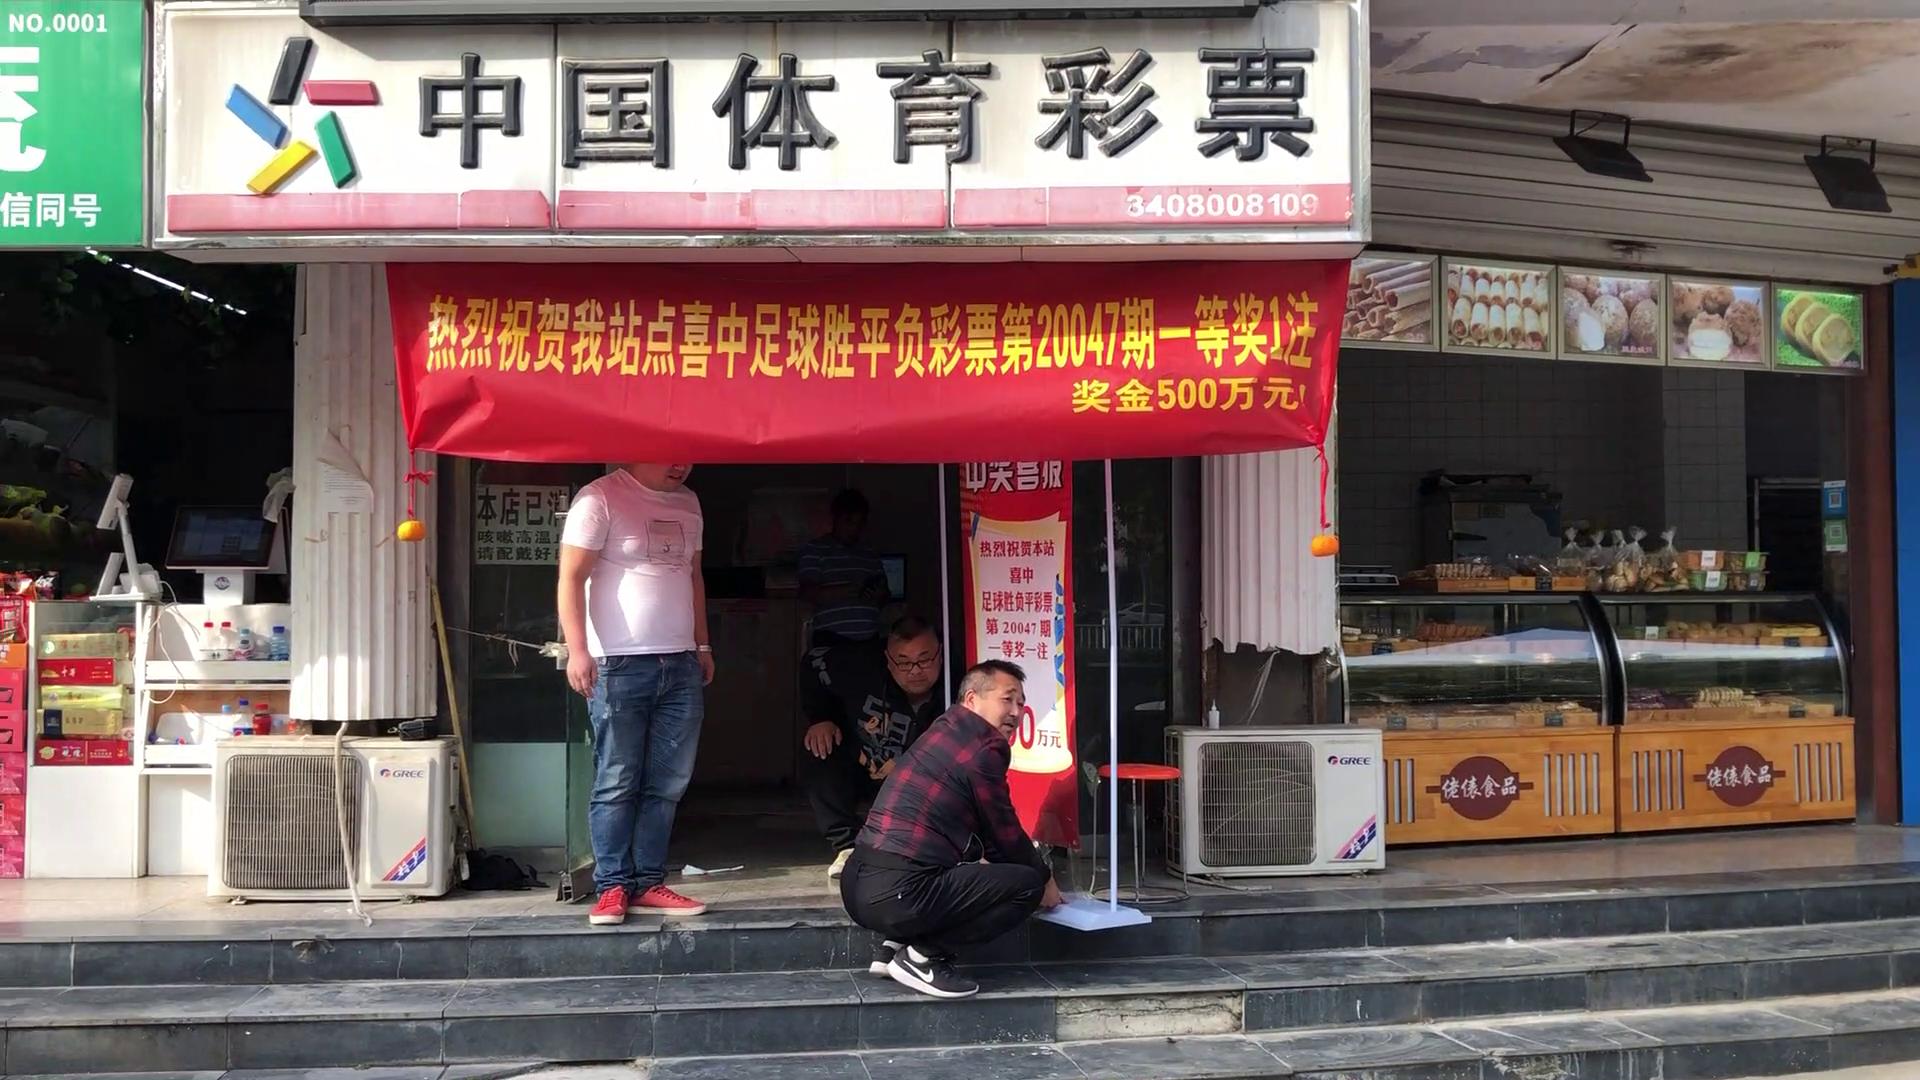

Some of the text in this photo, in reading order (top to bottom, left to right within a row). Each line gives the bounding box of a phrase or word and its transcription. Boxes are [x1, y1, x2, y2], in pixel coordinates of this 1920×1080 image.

[9, 14, 107, 33] NO.0001
[419, 48, 1315, 170] 中国体育彩票
[1126, 193, 1319, 217] 3408008109
[426, 291, 1319, 380] 热烈祝贺我站点喜中足球胜平负彩票第20047期一等奖1注
[980, 540, 1055, 557] 热烈祝贺本站
[1010, 567, 1034, 584] 喜中
[982, 591, 1053, 613] 足球胜负平彩票
[986, 618, 1051, 637] 第 20047 期
[988, 640, 1048, 660] 一等奖一注
[1340, 757, 1371, 766] GREE
[393, 770, 424, 778] GREE
